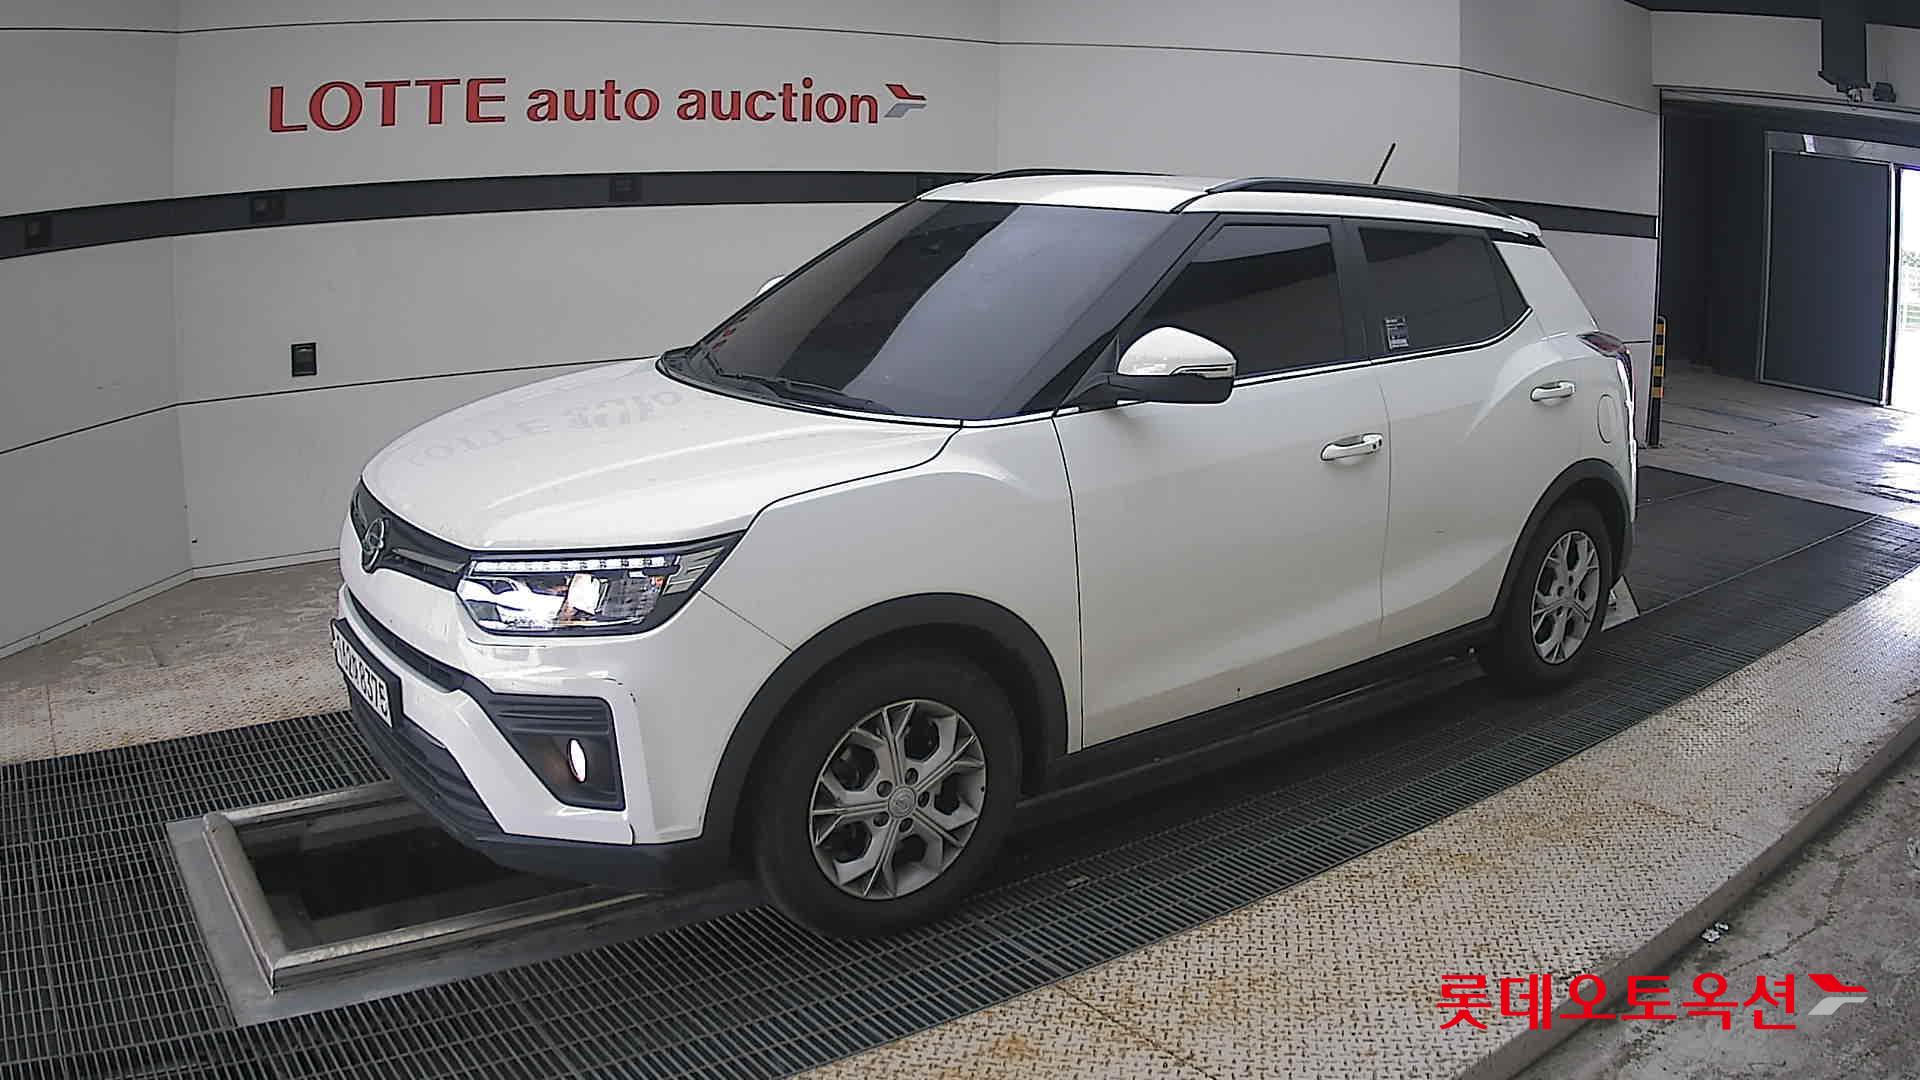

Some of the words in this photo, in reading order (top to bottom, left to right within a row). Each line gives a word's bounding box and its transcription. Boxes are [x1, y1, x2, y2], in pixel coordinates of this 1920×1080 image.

[269, 77, 507, 133] LOTTE
[526, 79, 661, 123] auto
[676, 77, 879, 125] auction
